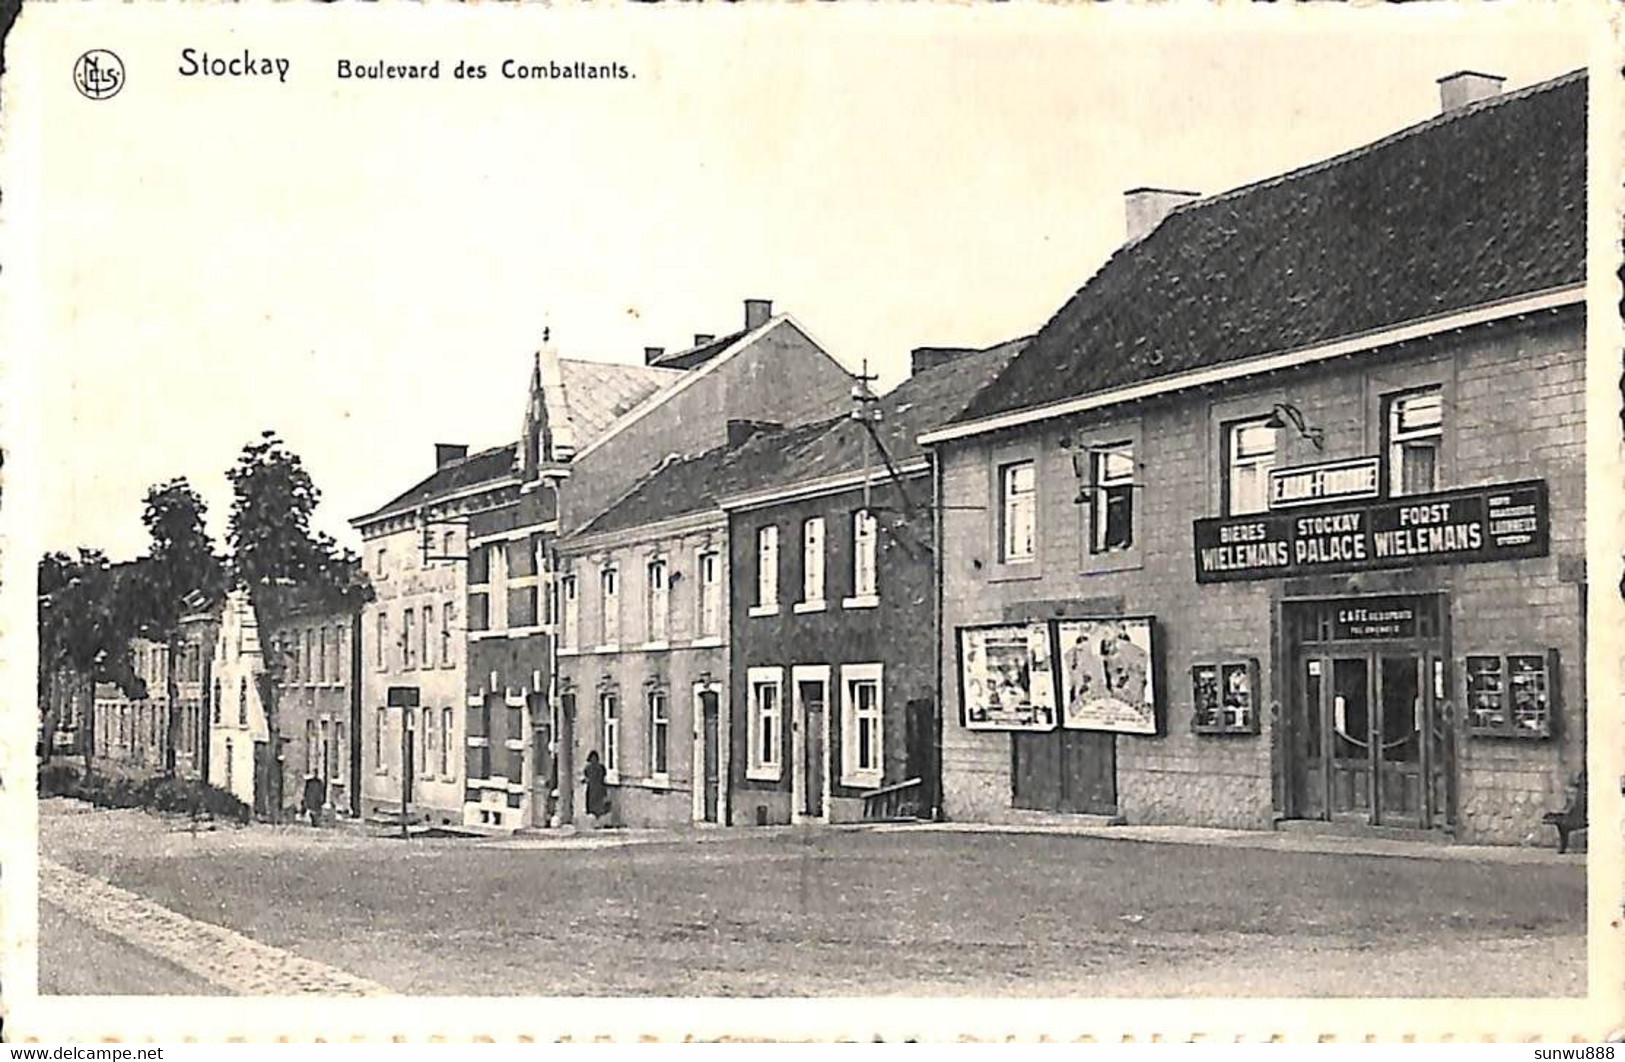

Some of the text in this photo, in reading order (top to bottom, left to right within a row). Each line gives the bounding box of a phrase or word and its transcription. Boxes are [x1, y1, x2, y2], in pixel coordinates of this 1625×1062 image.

[1298, 513, 1360, 535] STOCKAY
[1400, 503, 1451, 526] FORST
[1220, 524, 1266, 543] BIERES
[1374, 522, 1482, 557] WIELEMANS
[1201, 541, 1289, 571] WIELEMANS
[1295, 534, 1366, 564] PALACE
